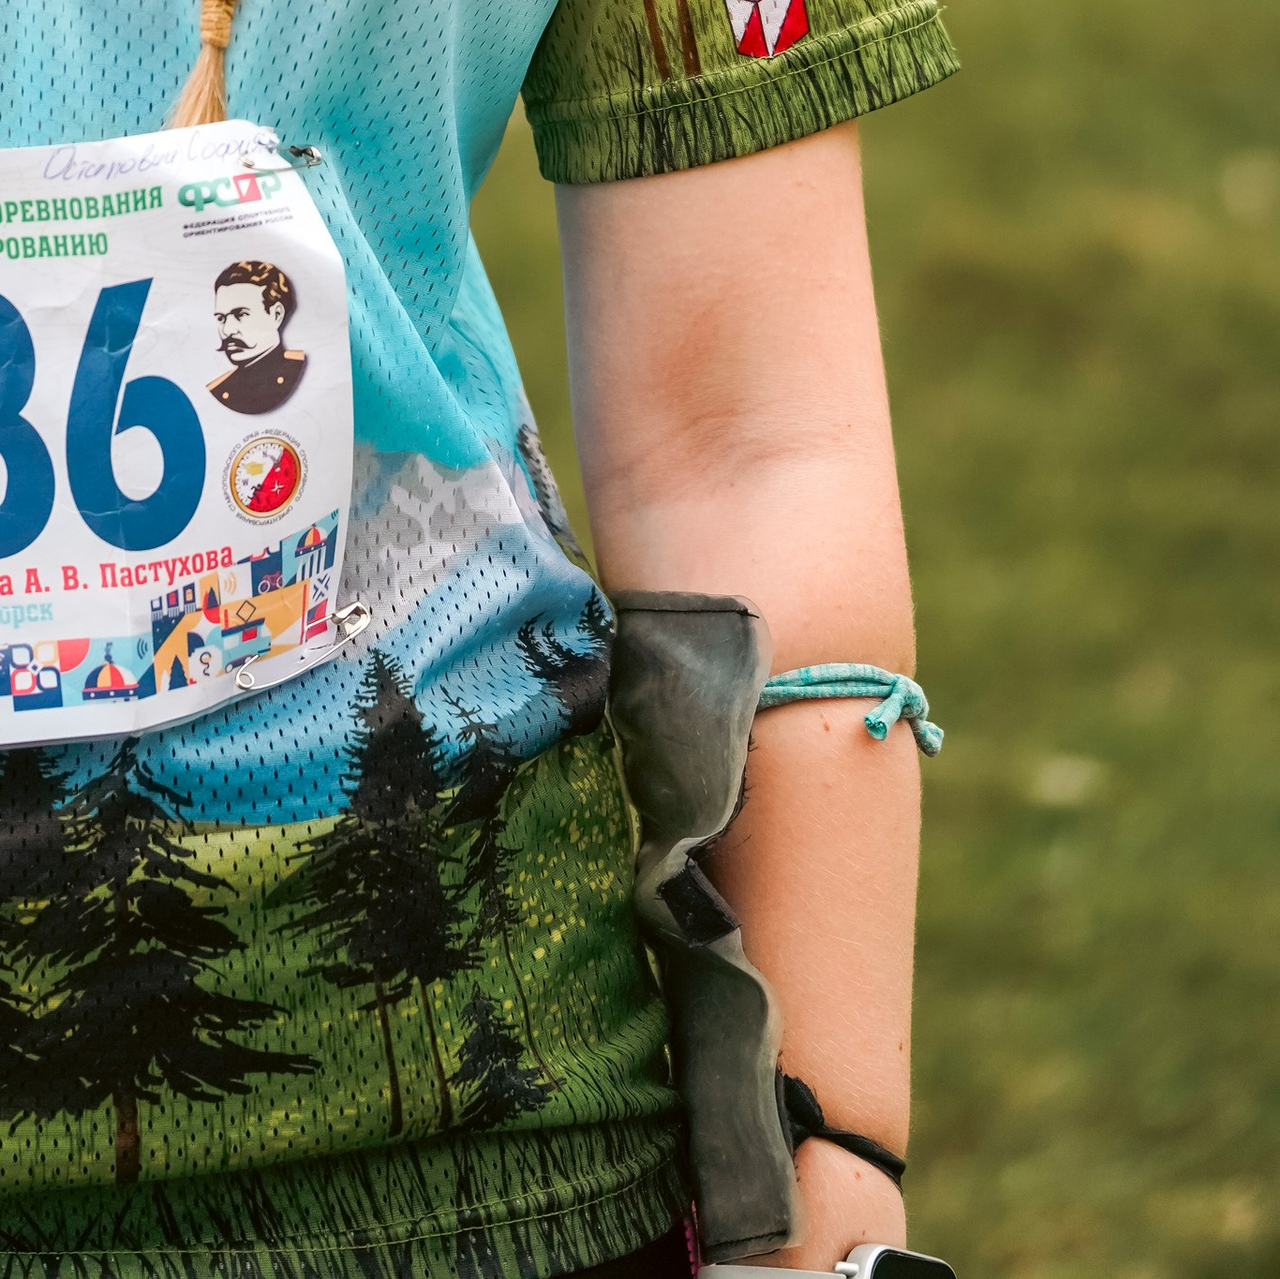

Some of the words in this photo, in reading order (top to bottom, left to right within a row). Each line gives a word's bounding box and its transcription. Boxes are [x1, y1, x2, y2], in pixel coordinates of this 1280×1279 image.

[25, 567, 51, 594] А.
[62, 564, 89, 591] В.
[99, 545, 234, 588] Пастухова
